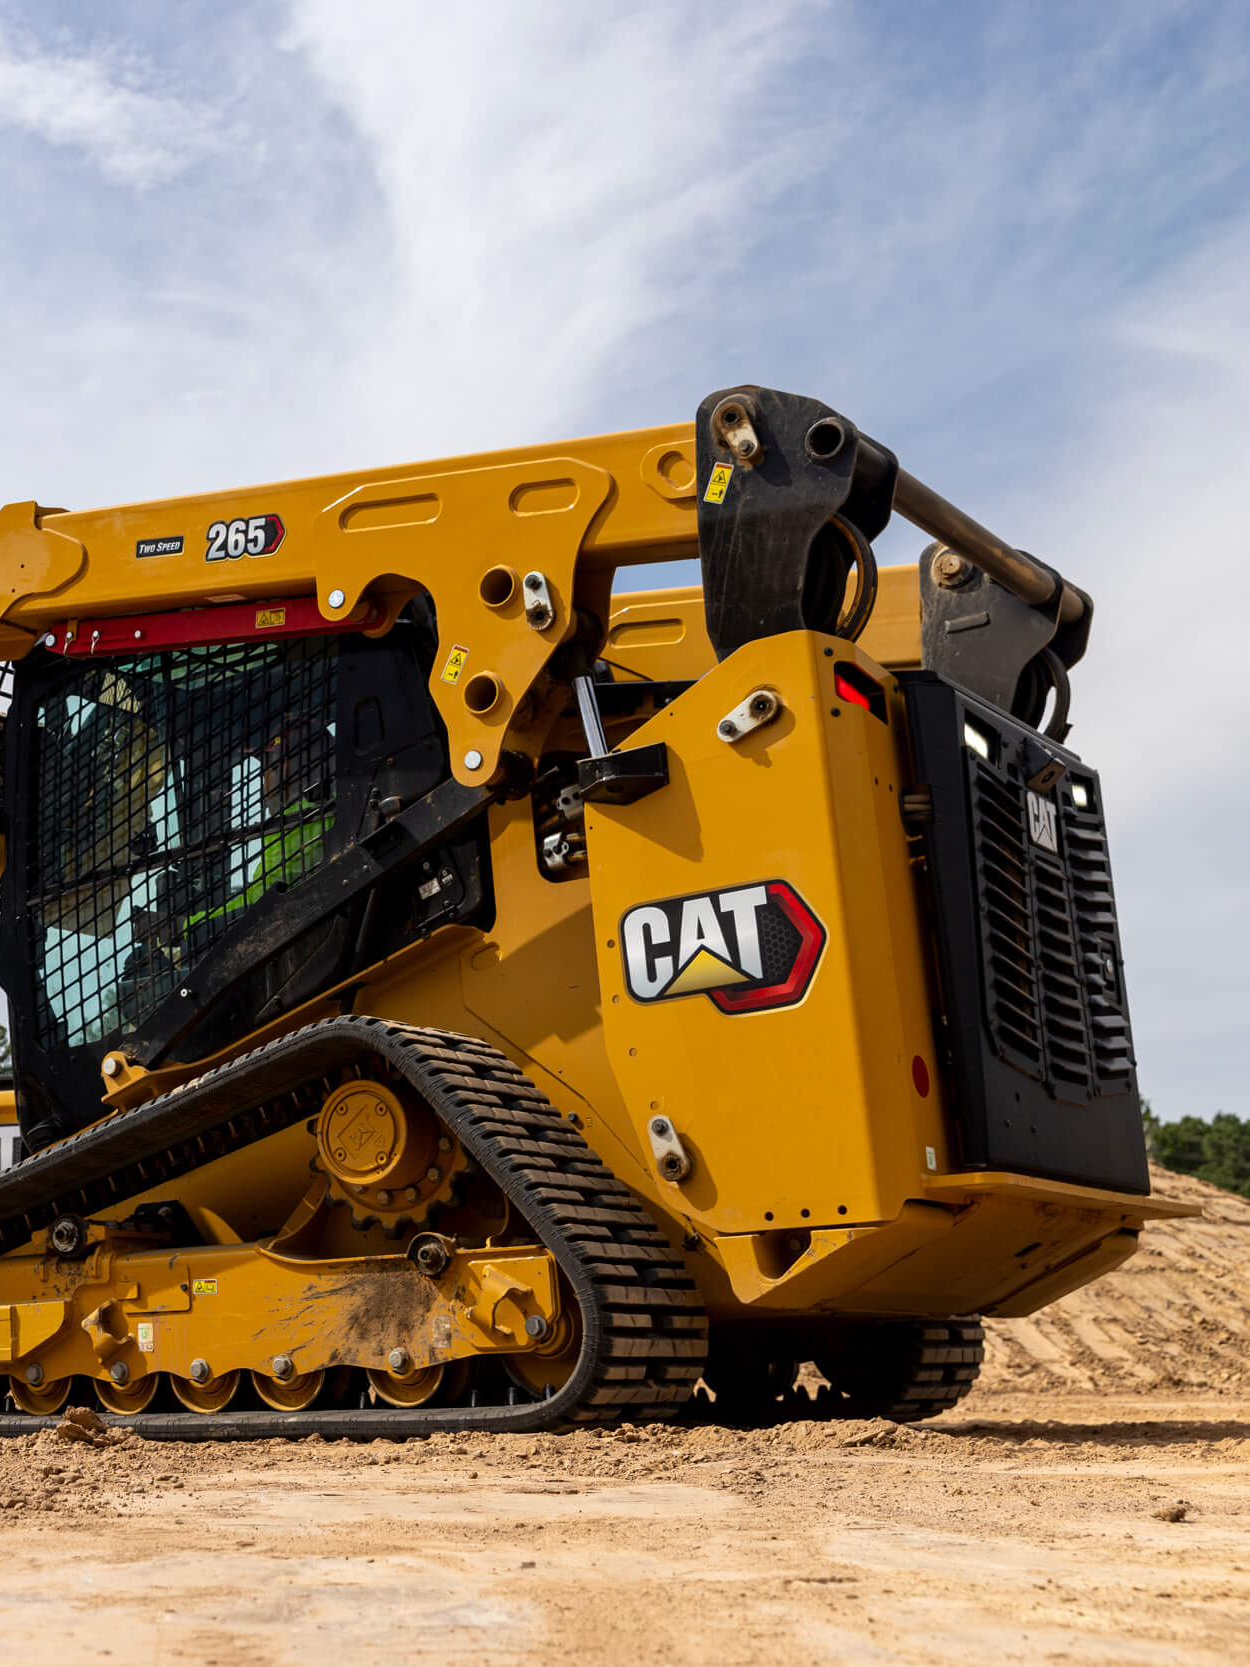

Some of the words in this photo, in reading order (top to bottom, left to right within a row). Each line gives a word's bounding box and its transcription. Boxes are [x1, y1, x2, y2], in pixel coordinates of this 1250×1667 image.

[140, 544, 156, 554] TWO
[156, 541, 181, 552] SPEED
[207, 517, 266, 560] 265
[1027, 791, 1058, 853] CAT
[623, 885, 768, 999] CAT
